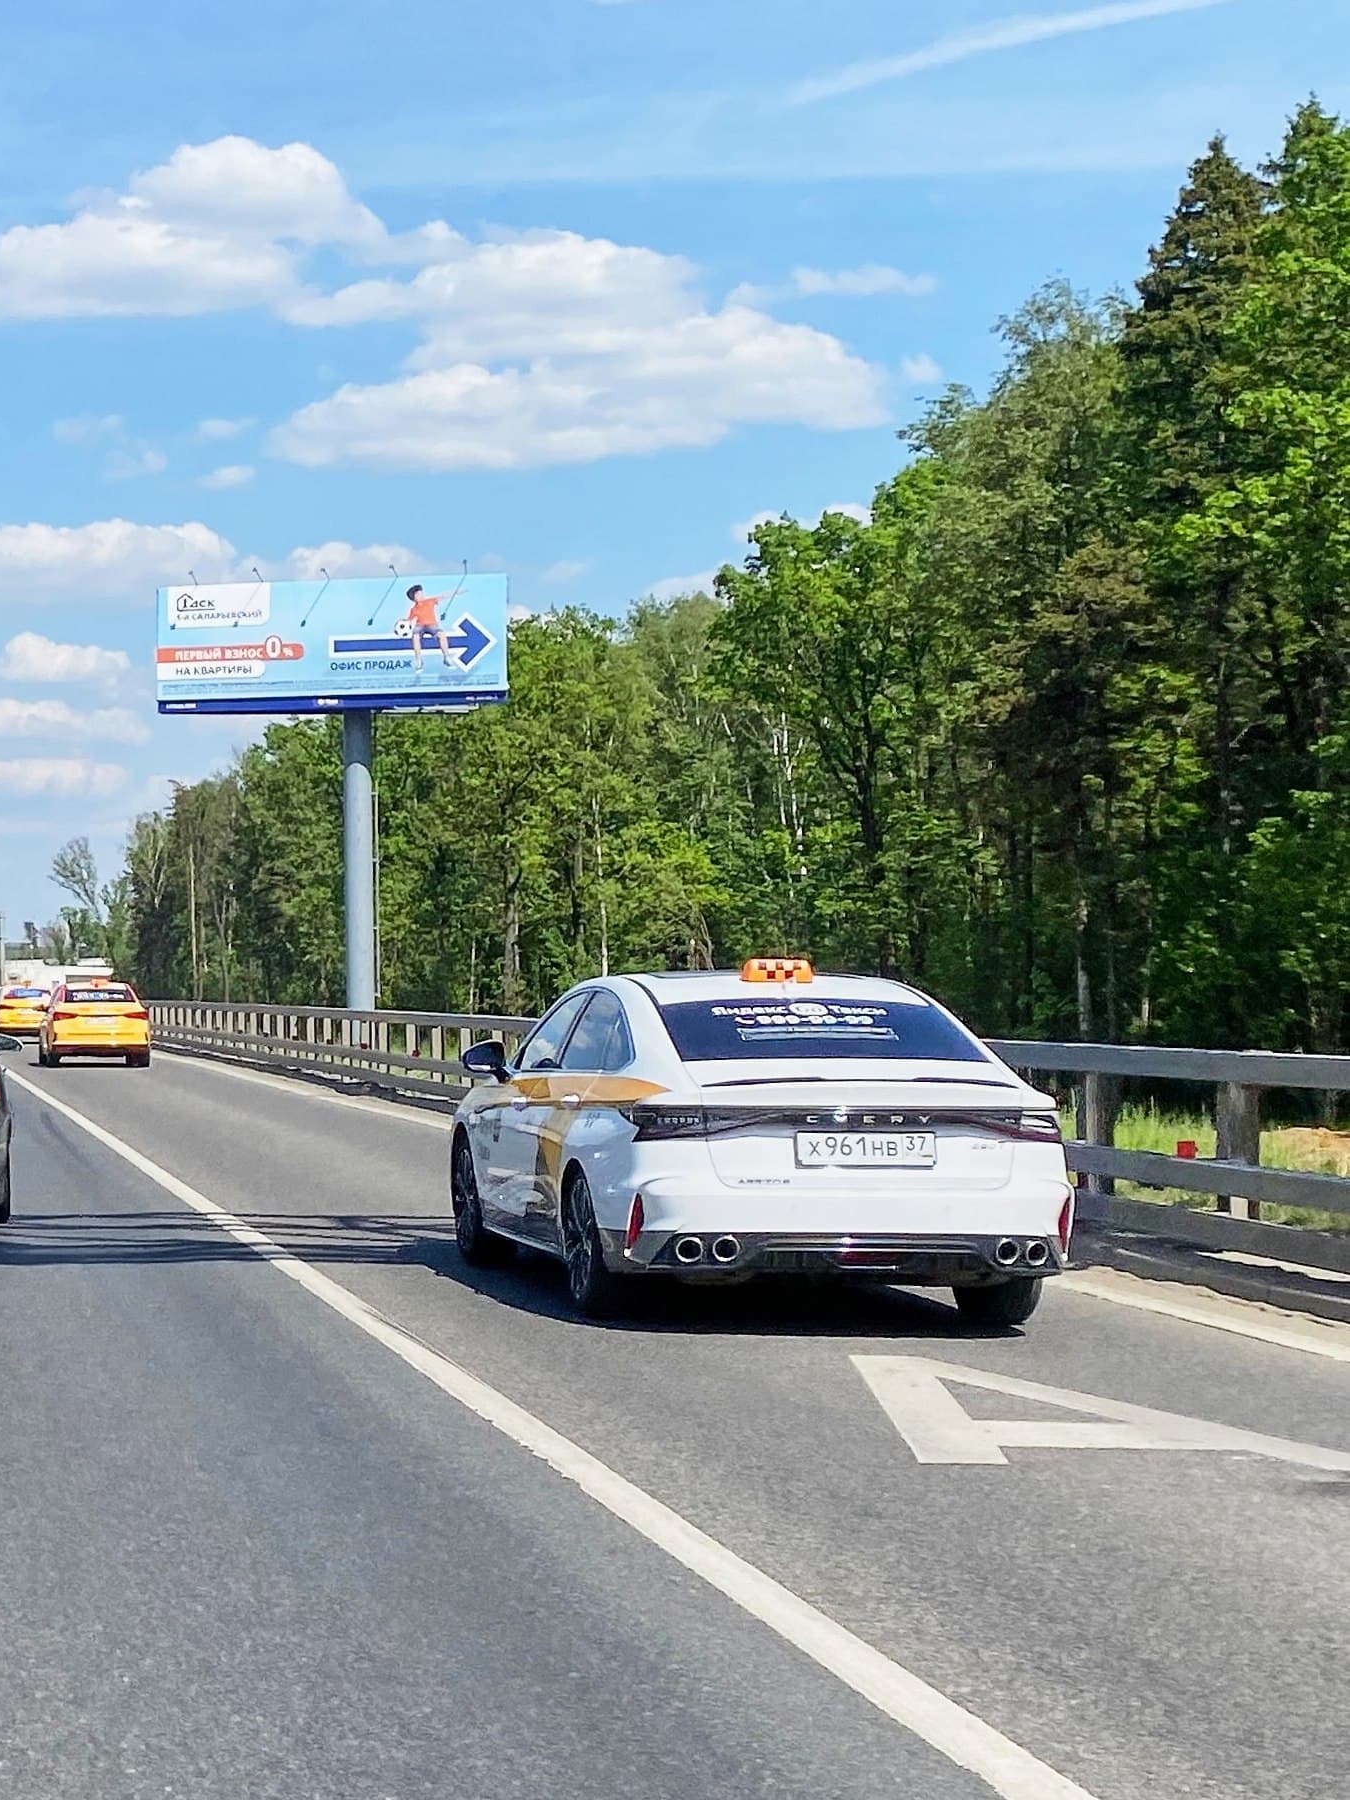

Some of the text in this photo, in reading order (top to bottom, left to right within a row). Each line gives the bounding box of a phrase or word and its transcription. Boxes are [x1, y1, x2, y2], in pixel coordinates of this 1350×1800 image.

[175, 648, 222, 661] ПЕРВЫЙ
[225, 647, 264, 660] ВЗНОС
[175, 665, 252, 676] НА КВАРТИРЫ
[330, 659, 412, 671] ОФИС ПРОДАЖ
[711, 1006, 788, 1016] Яндекс
[827, 1005, 888, 1016] Такси
[905, 1135, 926, 1151] 37
